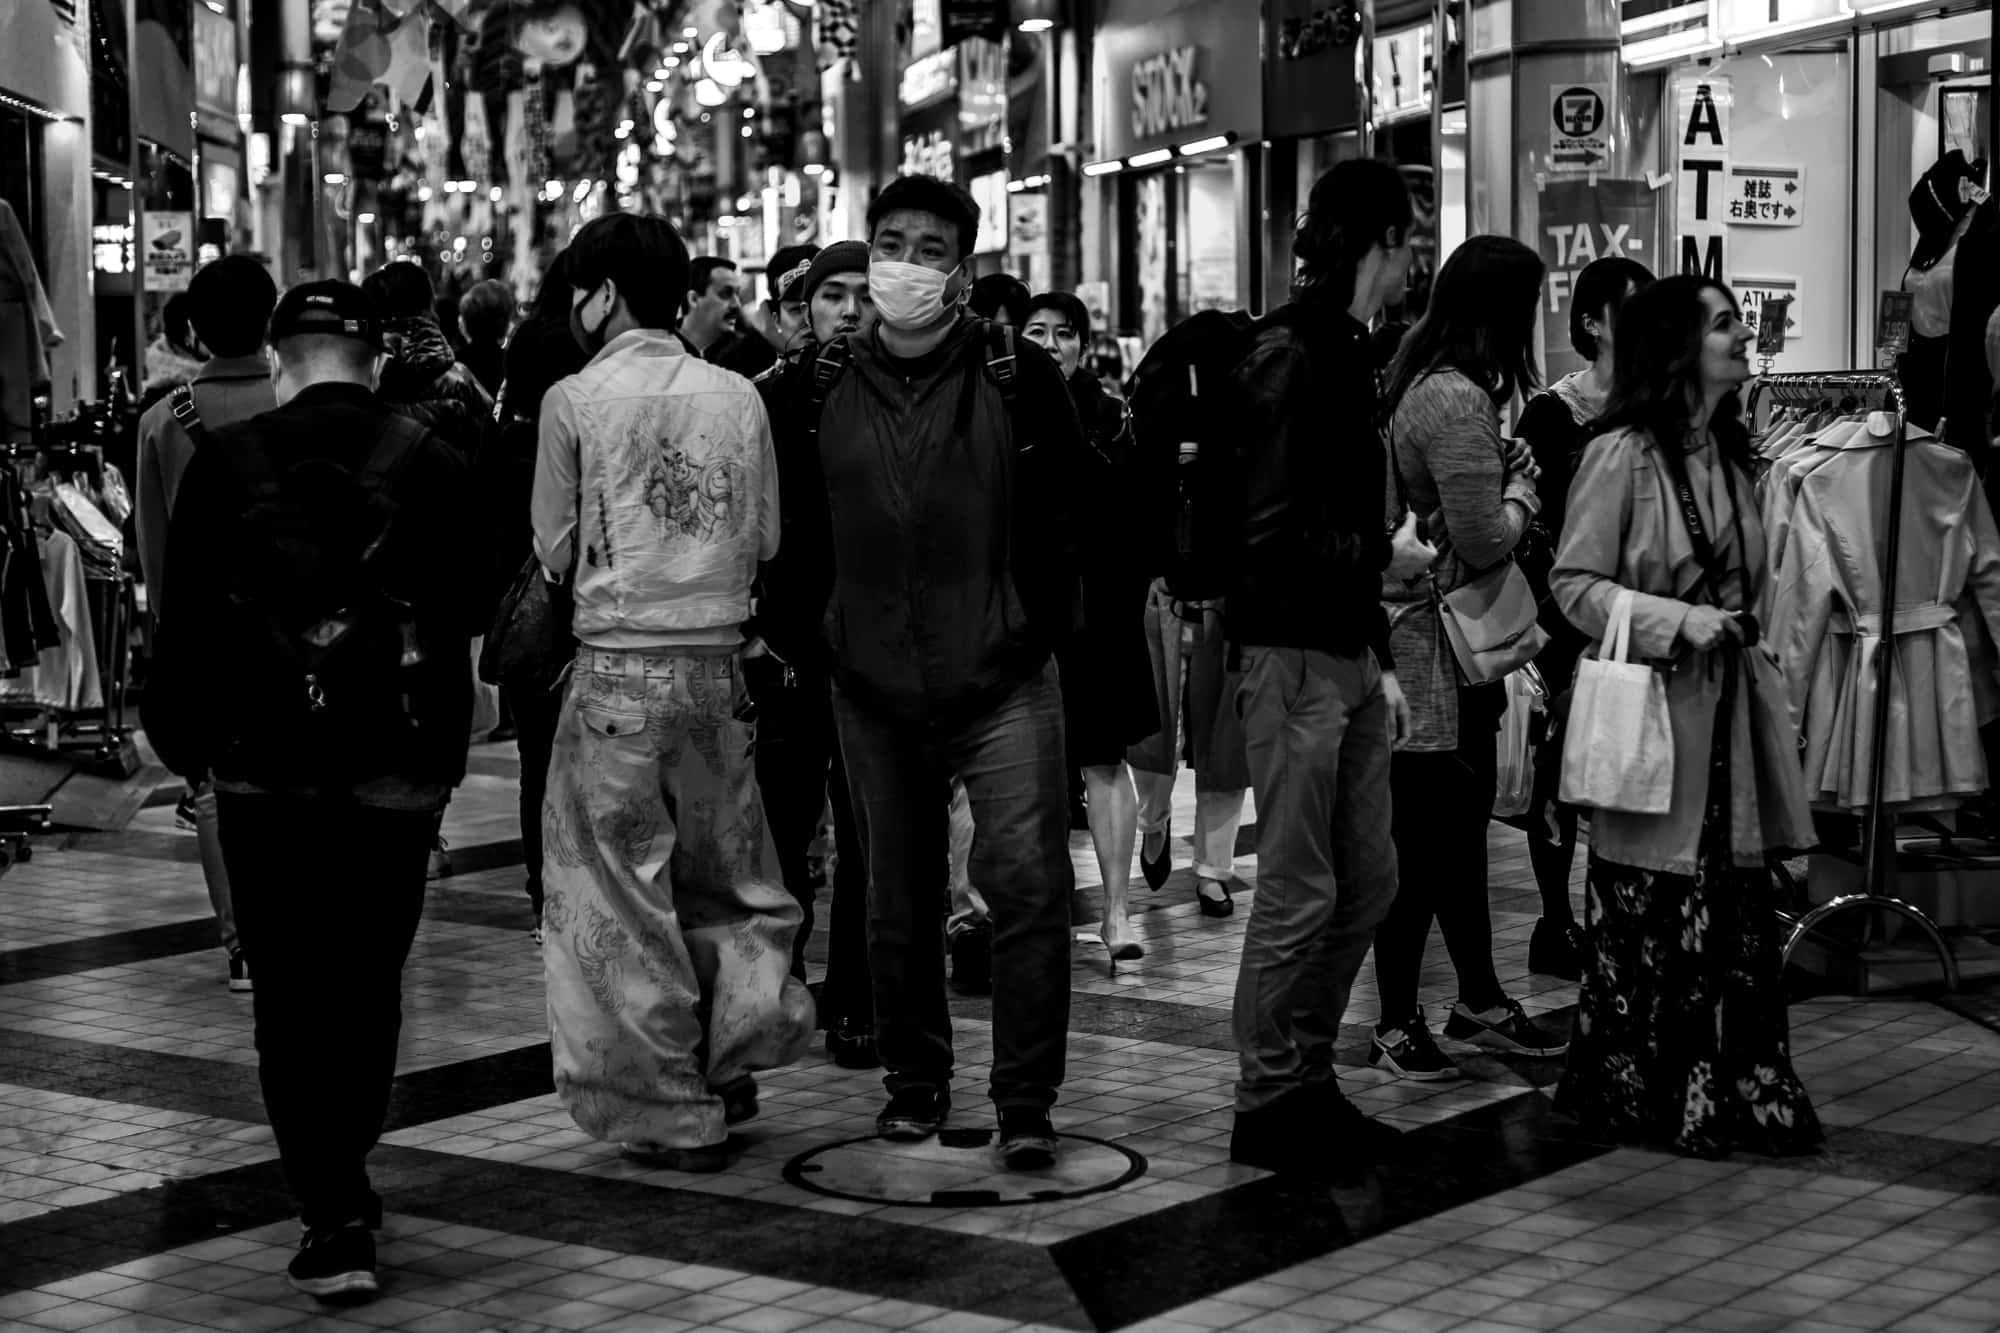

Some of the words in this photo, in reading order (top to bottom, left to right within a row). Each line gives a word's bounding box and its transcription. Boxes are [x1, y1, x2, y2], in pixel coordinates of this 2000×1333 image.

[1683, 84, 1724, 281] ATM
[1744, 179, 1771, 198] 雑誌
[1730, 199, 1783, 220] 右奥です
